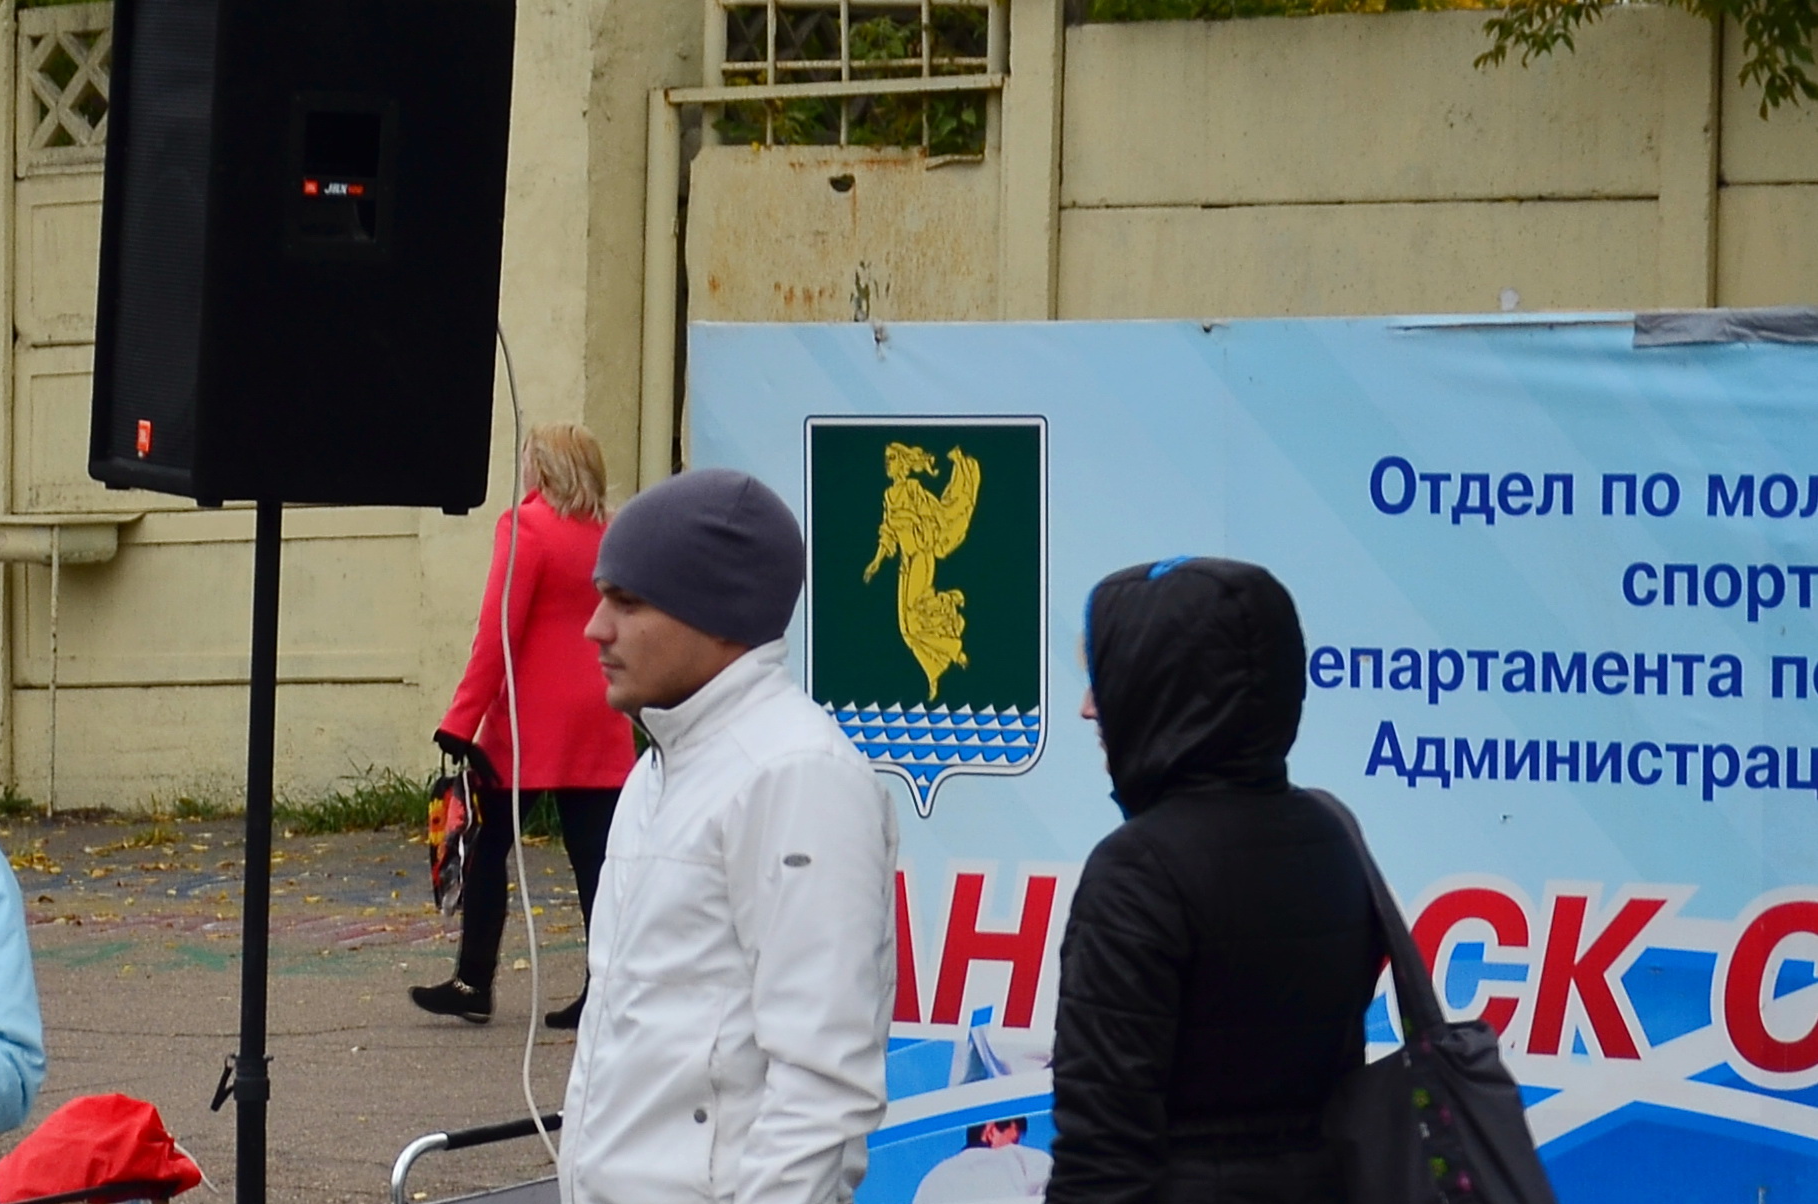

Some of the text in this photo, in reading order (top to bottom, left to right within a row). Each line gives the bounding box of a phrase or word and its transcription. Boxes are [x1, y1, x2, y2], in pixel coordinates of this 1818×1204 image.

[1369, 456, 1574, 525] Отдел
[1601, 472, 1681, 518] по
[1622, 562, 1818, 623] спорт
[1309, 645, 1818, 705] епартамента п
[1364, 720, 1818, 802] Администрац
